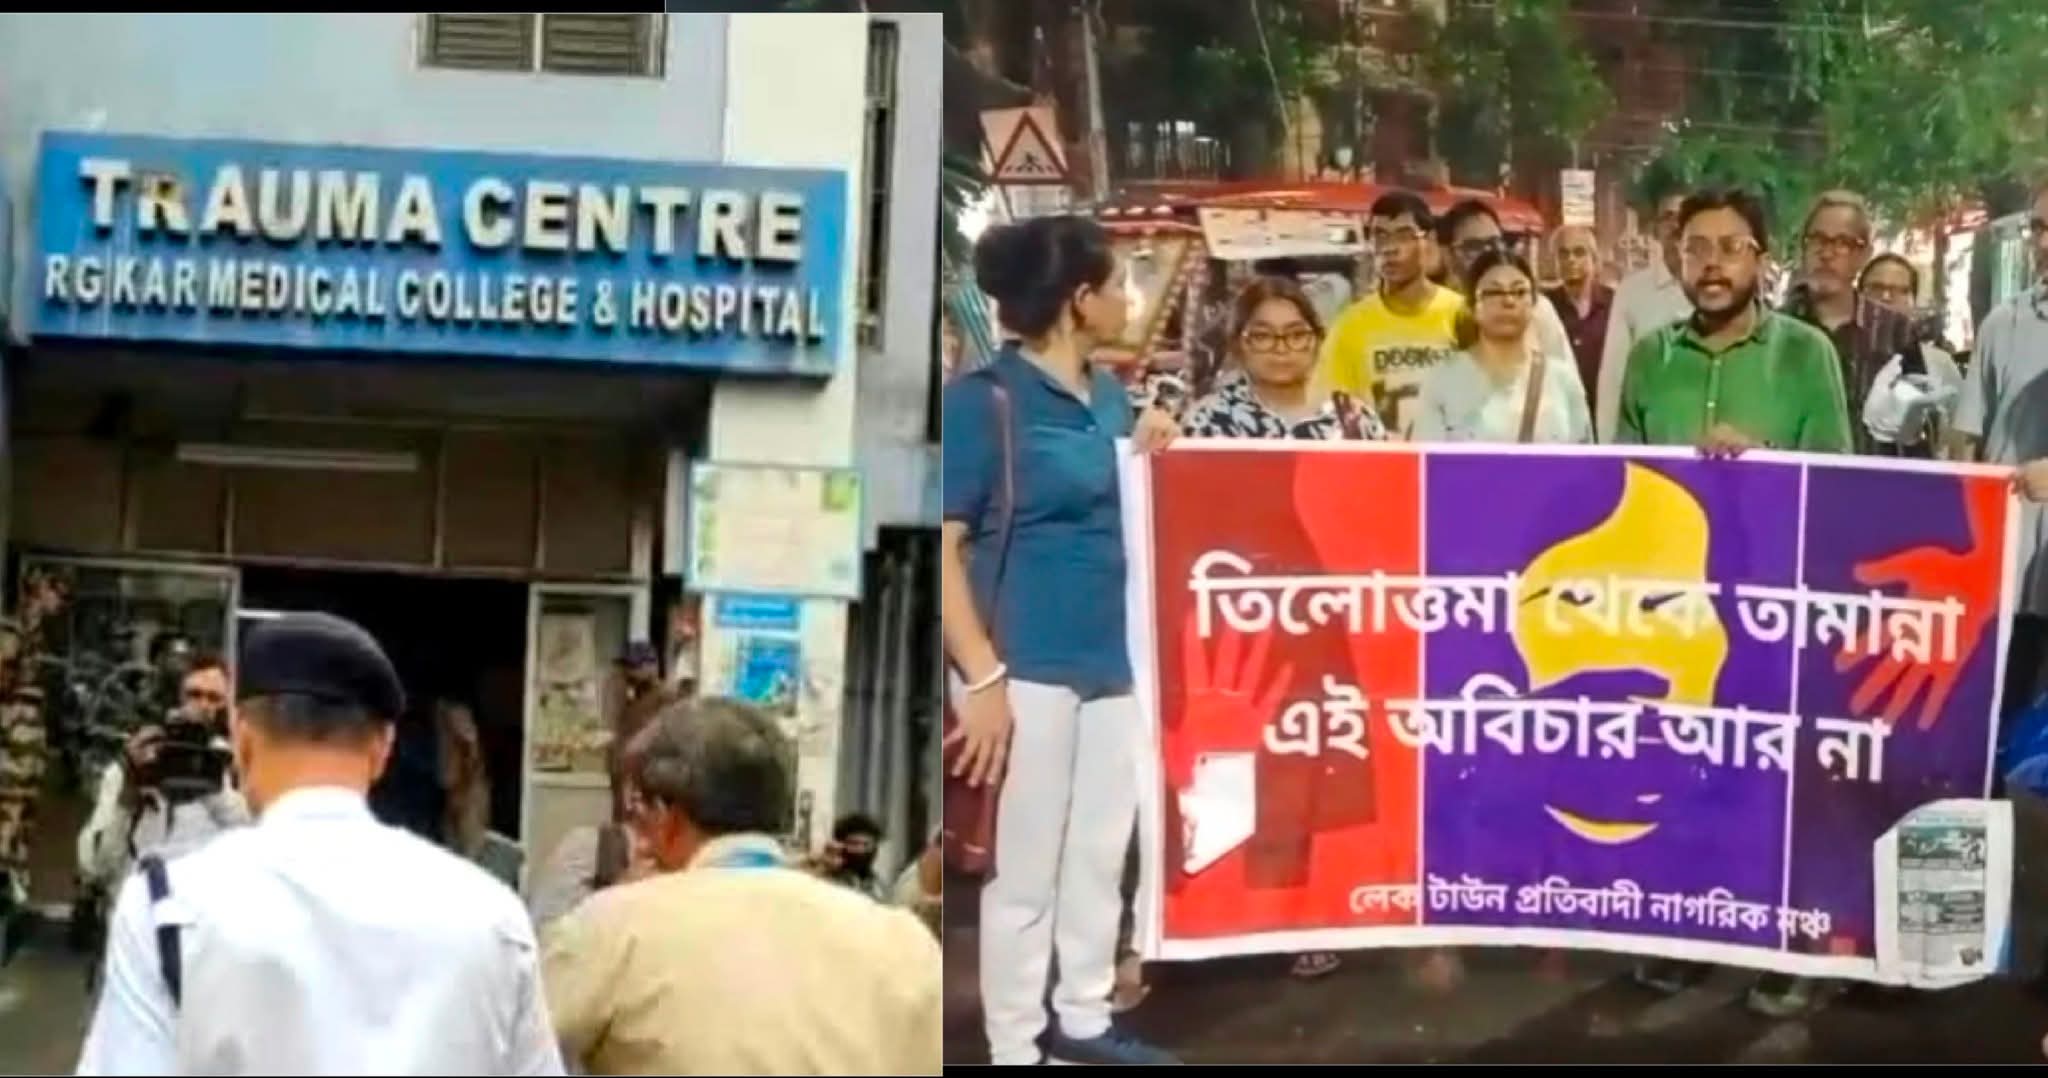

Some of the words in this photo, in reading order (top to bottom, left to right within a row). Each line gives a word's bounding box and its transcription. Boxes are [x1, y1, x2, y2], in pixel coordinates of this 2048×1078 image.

[79, 157, 442, 246] TRAUMA
[463, 177, 803, 262] CENTRE
[112, 255, 198, 306] KAR
[208, 259, 385, 315] MEDICAL
[398, 268, 578, 326] COLLEGE
[593, 277, 616, 329] &
[630, 279, 827, 338] HOSPITAL
[1188, 550, 1523, 638] তিলোত্তমা
[1544, 572, 1721, 638] থেকে
[1735, 583, 1966, 665] তামান্না
[1263, 673, 1370, 760] এই
[1384, 672, 1643, 760] অবিচার
[1650, 699, 1801, 772] আর
[1815, 715, 1893, 783] না
[1348, 881, 1418, 915] লেক
[1425, 872, 1507, 914] টাউন
[1515, 876, 1644, 921] প্রতিবাদী
[1649, 885, 1769, 932] নাগরিক
[1777, 904, 1833, 940] মঞ্চ
